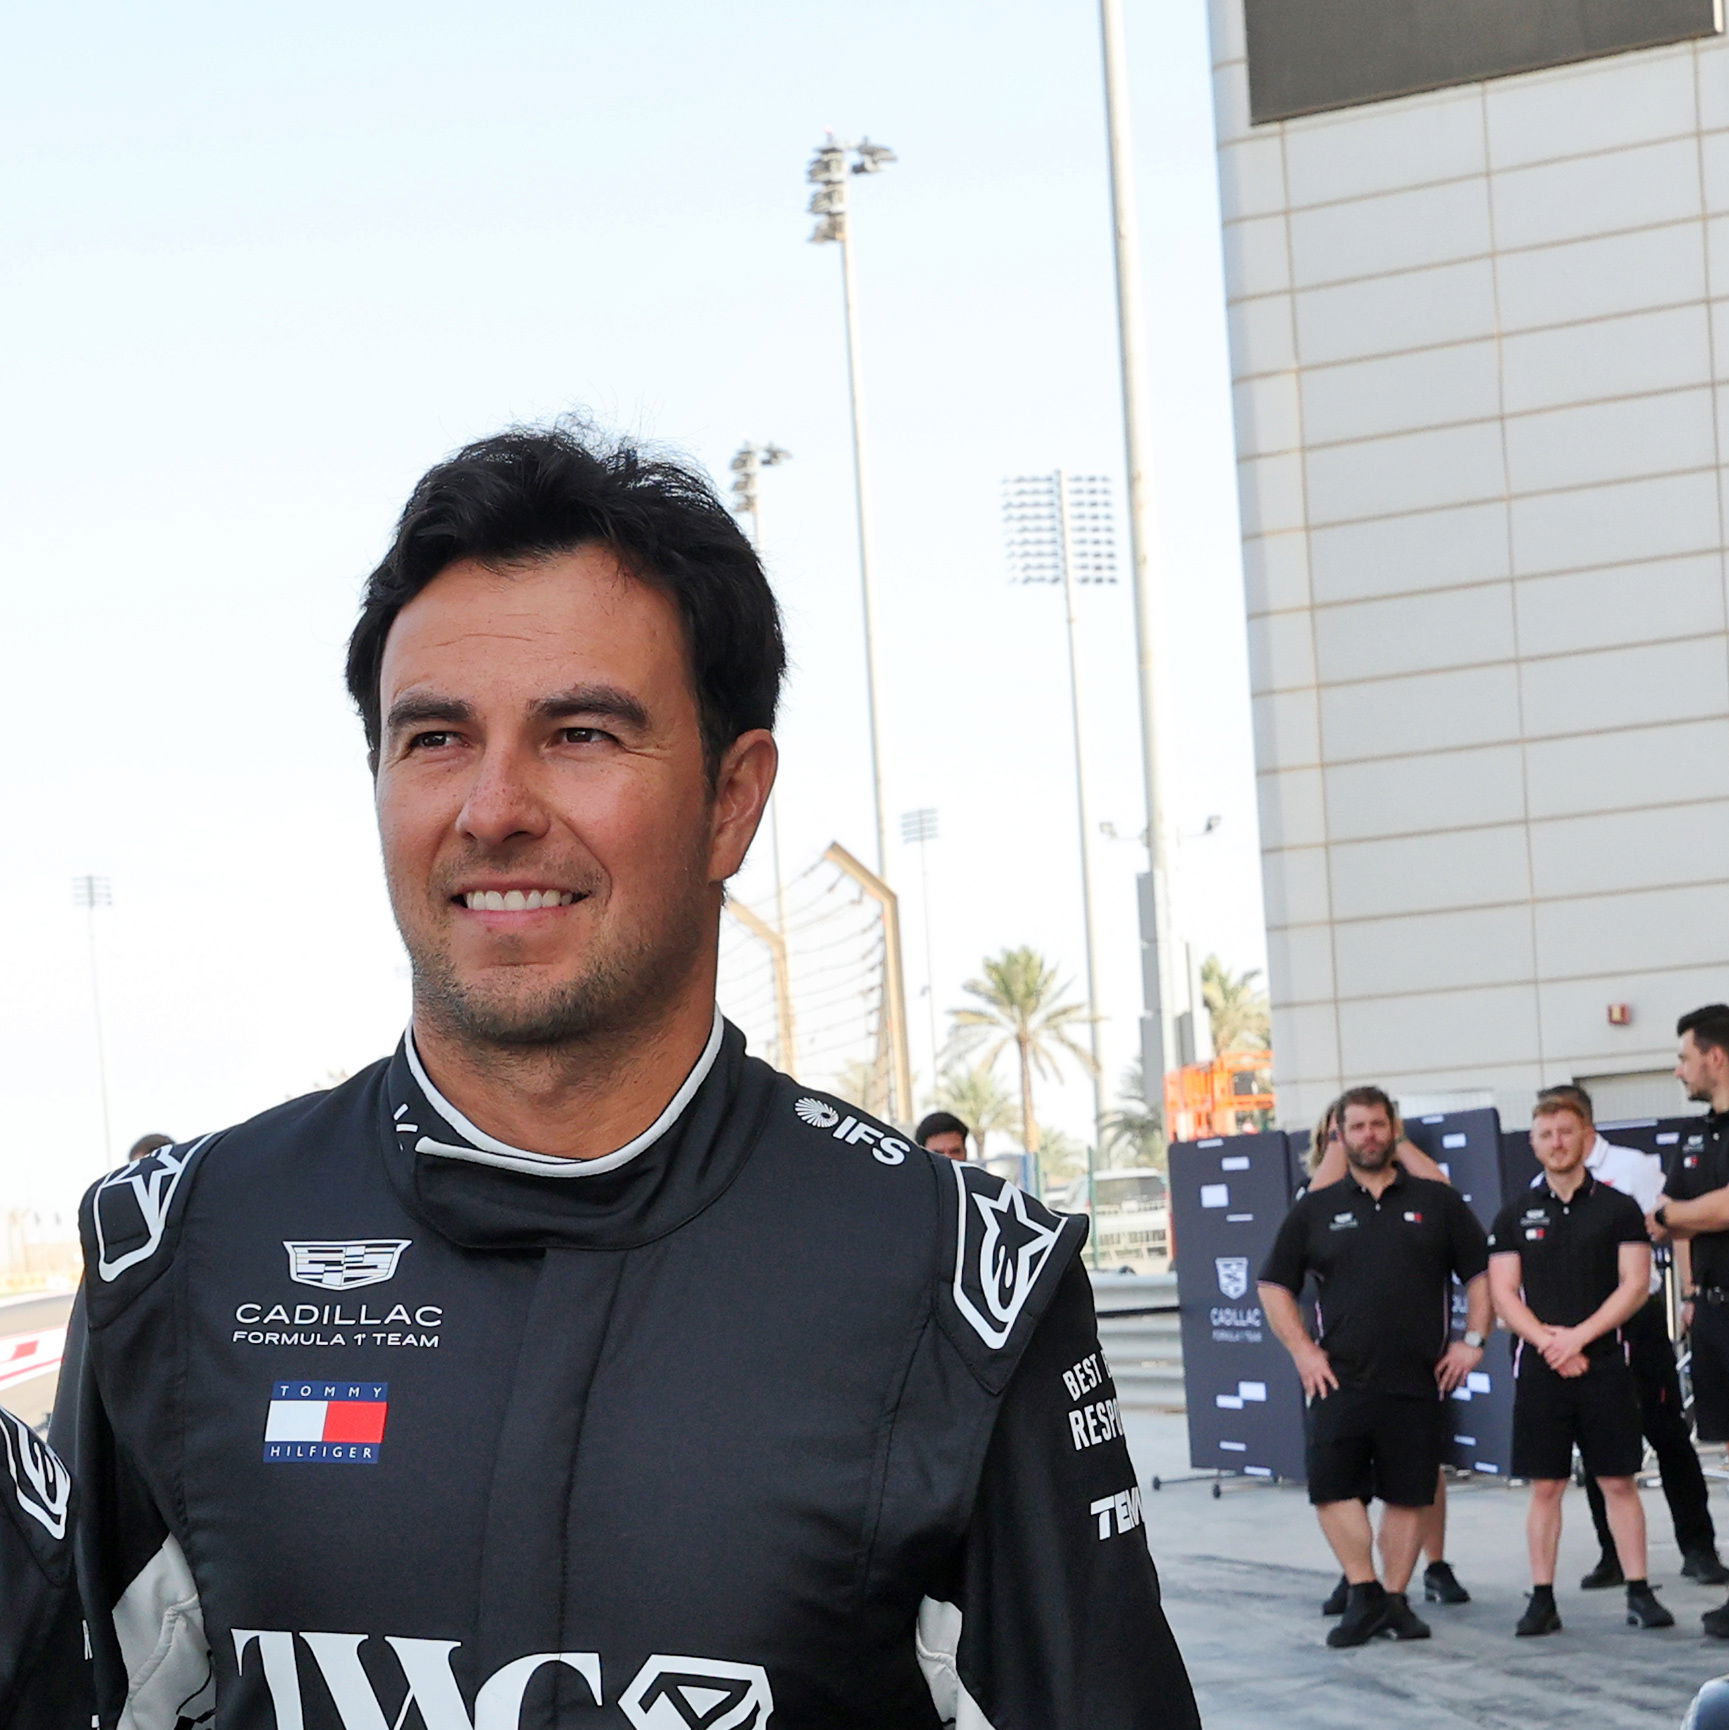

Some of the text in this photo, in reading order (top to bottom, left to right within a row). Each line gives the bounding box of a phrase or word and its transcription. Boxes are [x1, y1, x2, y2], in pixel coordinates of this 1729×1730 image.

[832, 1114, 911, 1166] IFS
[235, 1303, 443, 1328] CADILLAC
[1209, 1306, 1262, 1328] CADILLAC
[232, 1330, 347, 1347] FORMULA
[372, 1332, 441, 1349] TEAM
[1062, 1353, 1103, 1402] BEST
[279, 1384, 383, 1400] TOMMY
[269, 1444, 373, 1460] HILFIGER
